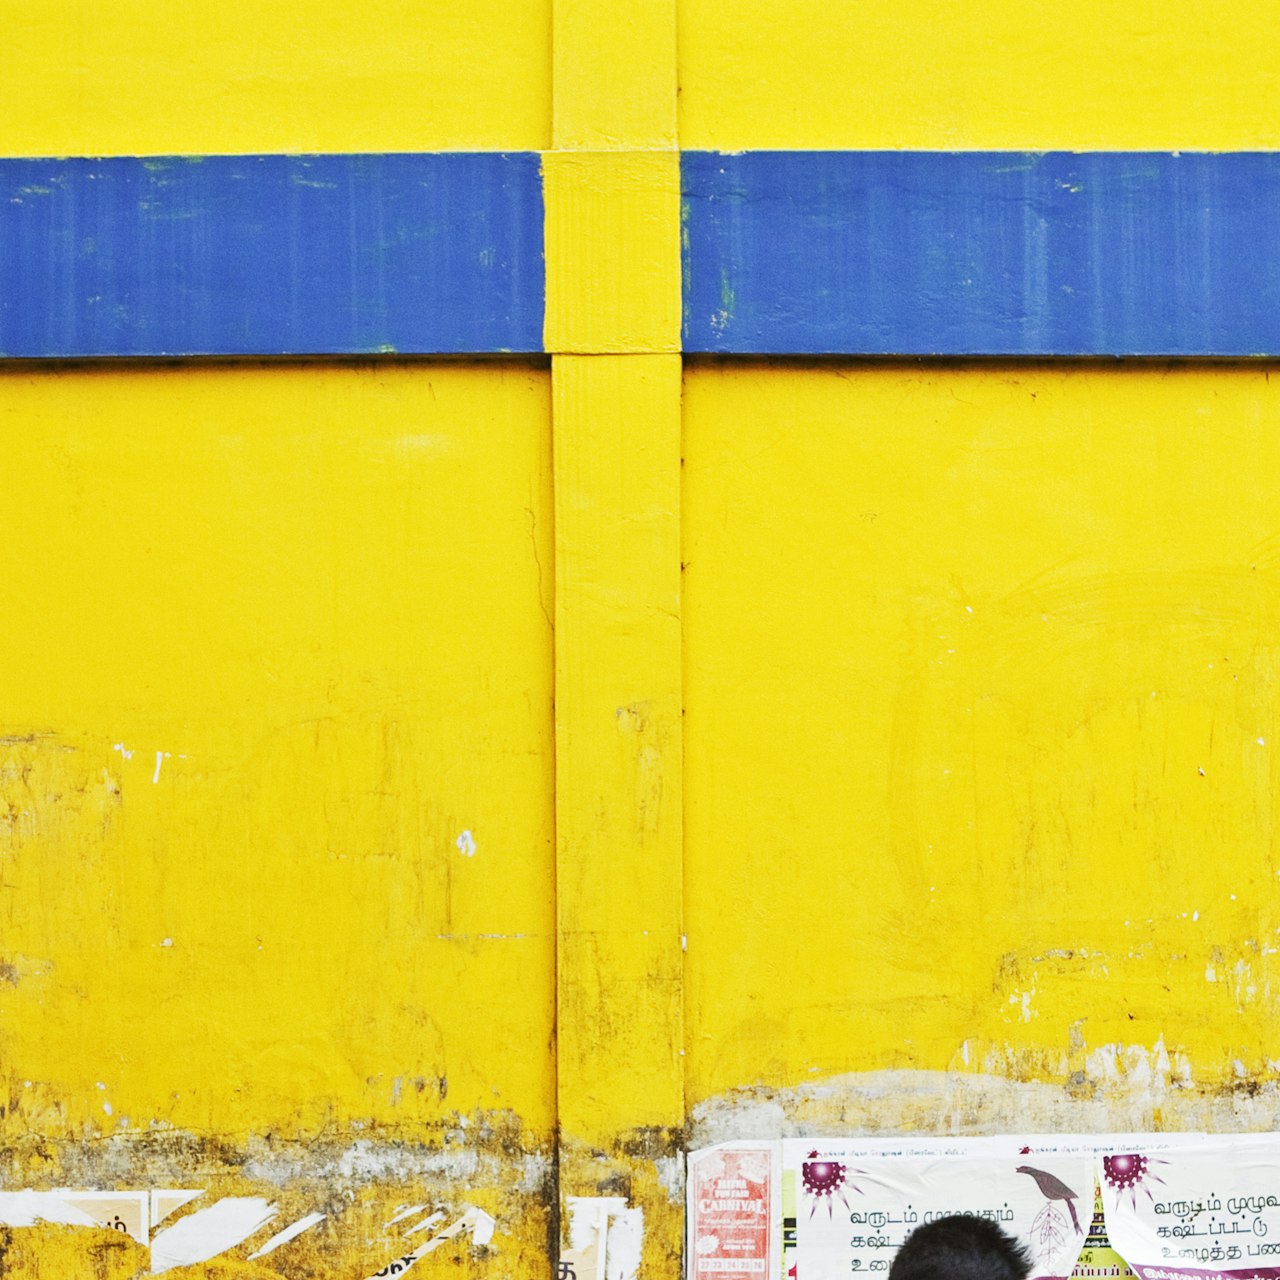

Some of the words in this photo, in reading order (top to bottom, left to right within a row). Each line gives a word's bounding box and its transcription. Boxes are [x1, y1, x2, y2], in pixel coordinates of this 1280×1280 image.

[700, 1199, 766, 1215] CARNIVAL
[850, 1204, 918, 1227] வருடம்
[1154, 1192, 1222, 1217] வருடம்
[1156, 1215, 1268, 1238] கஷ்டப்பட்டு
